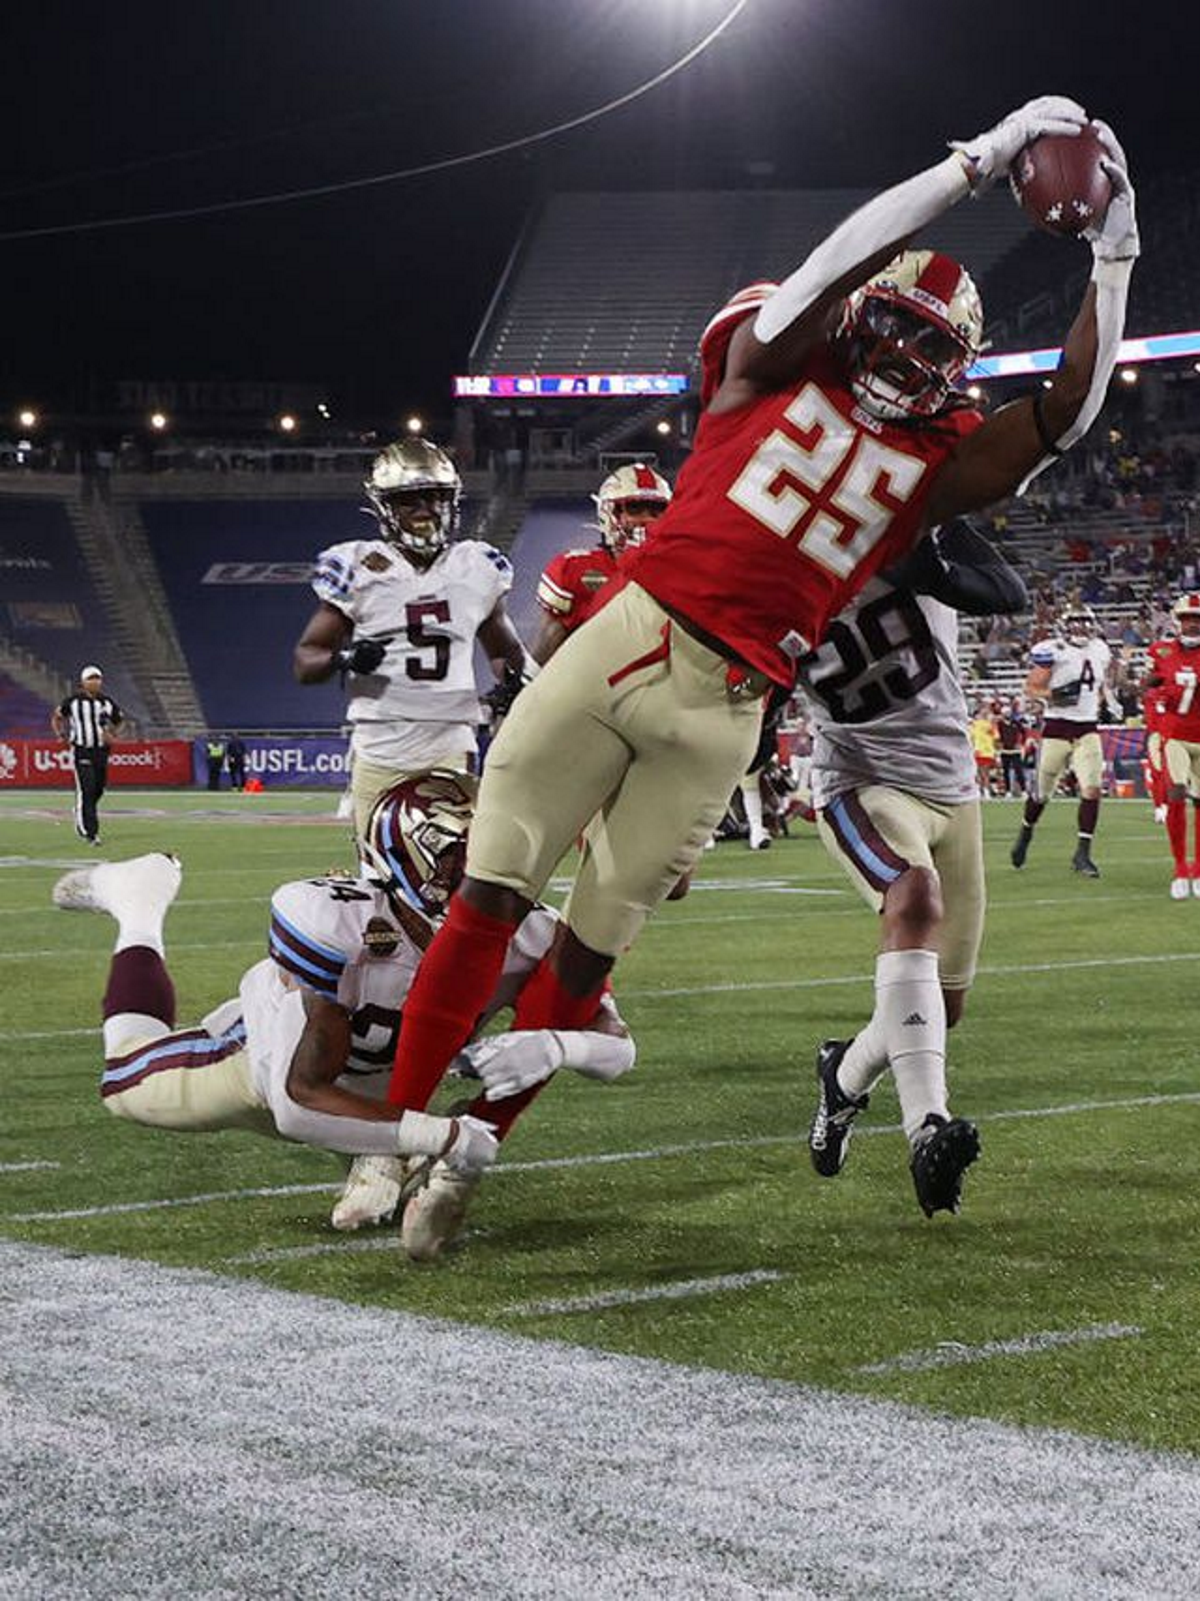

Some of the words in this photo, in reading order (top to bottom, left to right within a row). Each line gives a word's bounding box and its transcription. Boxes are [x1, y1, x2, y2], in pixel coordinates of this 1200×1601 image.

[726, 378, 927, 582] 25
[202, 562, 317, 585] US
[405, 599, 451, 681] 5
[801, 590, 940, 724] 29
[1080, 659, 1096, 692] 4
[1175, 672, 1198, 715] 7
